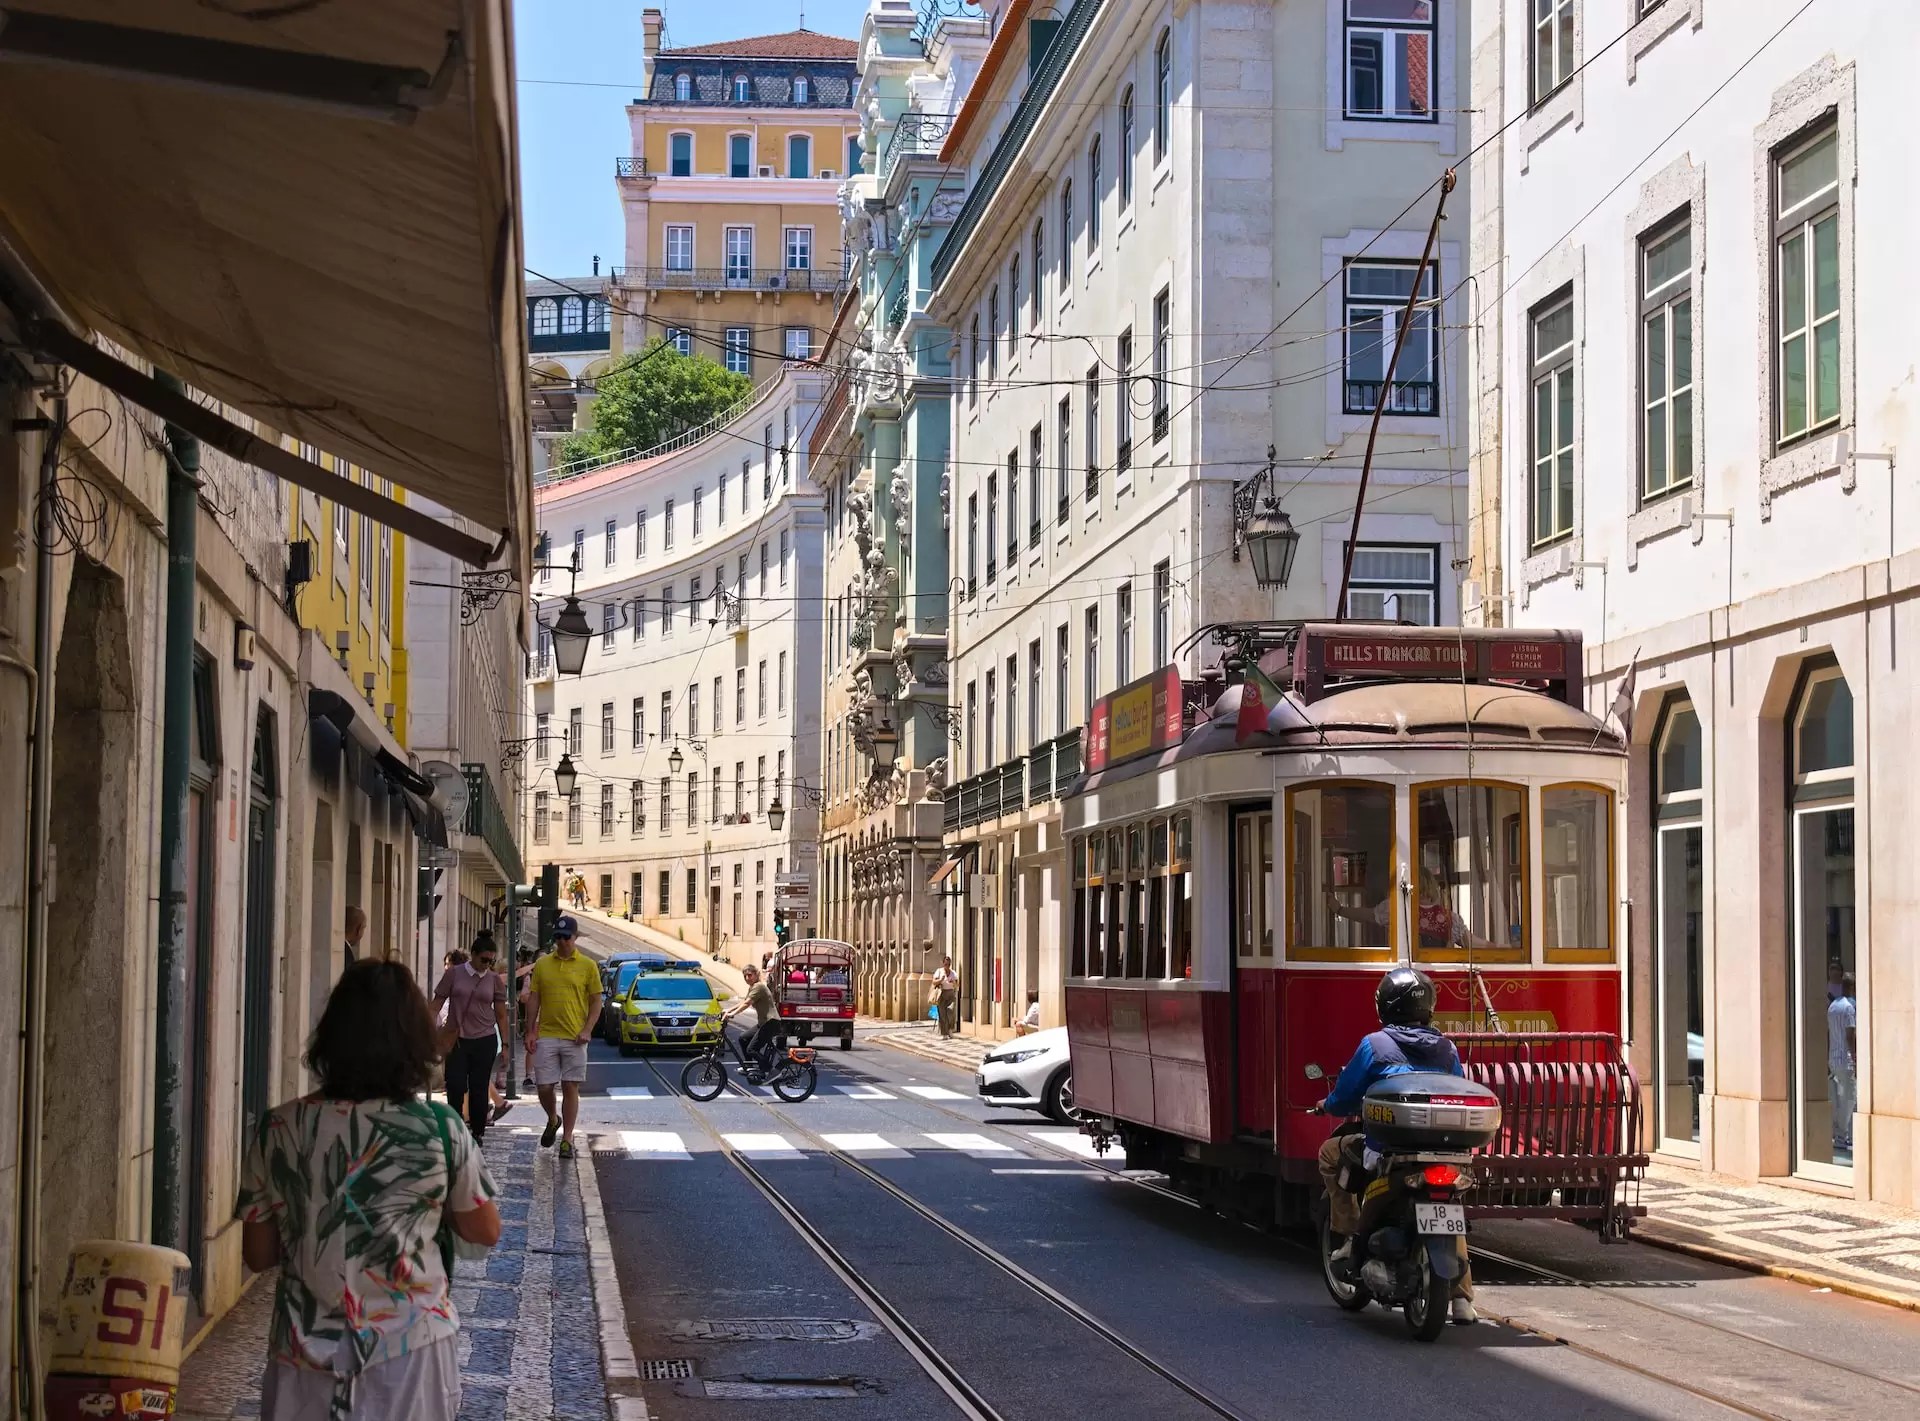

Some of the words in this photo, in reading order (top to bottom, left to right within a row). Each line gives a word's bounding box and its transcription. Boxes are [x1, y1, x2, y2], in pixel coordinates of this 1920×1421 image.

[1334, 645, 1373, 662] HILLS
[1376, 645, 1432, 662] TRAMCAR
[1434, 646, 1468, 663] TOUR
[1513, 645, 1539, 653] LISBON
[1511, 661, 1542, 669] TRAMCAR
[637, 815, 645, 826] S
[1433, 1205, 1447, 1219] 18
